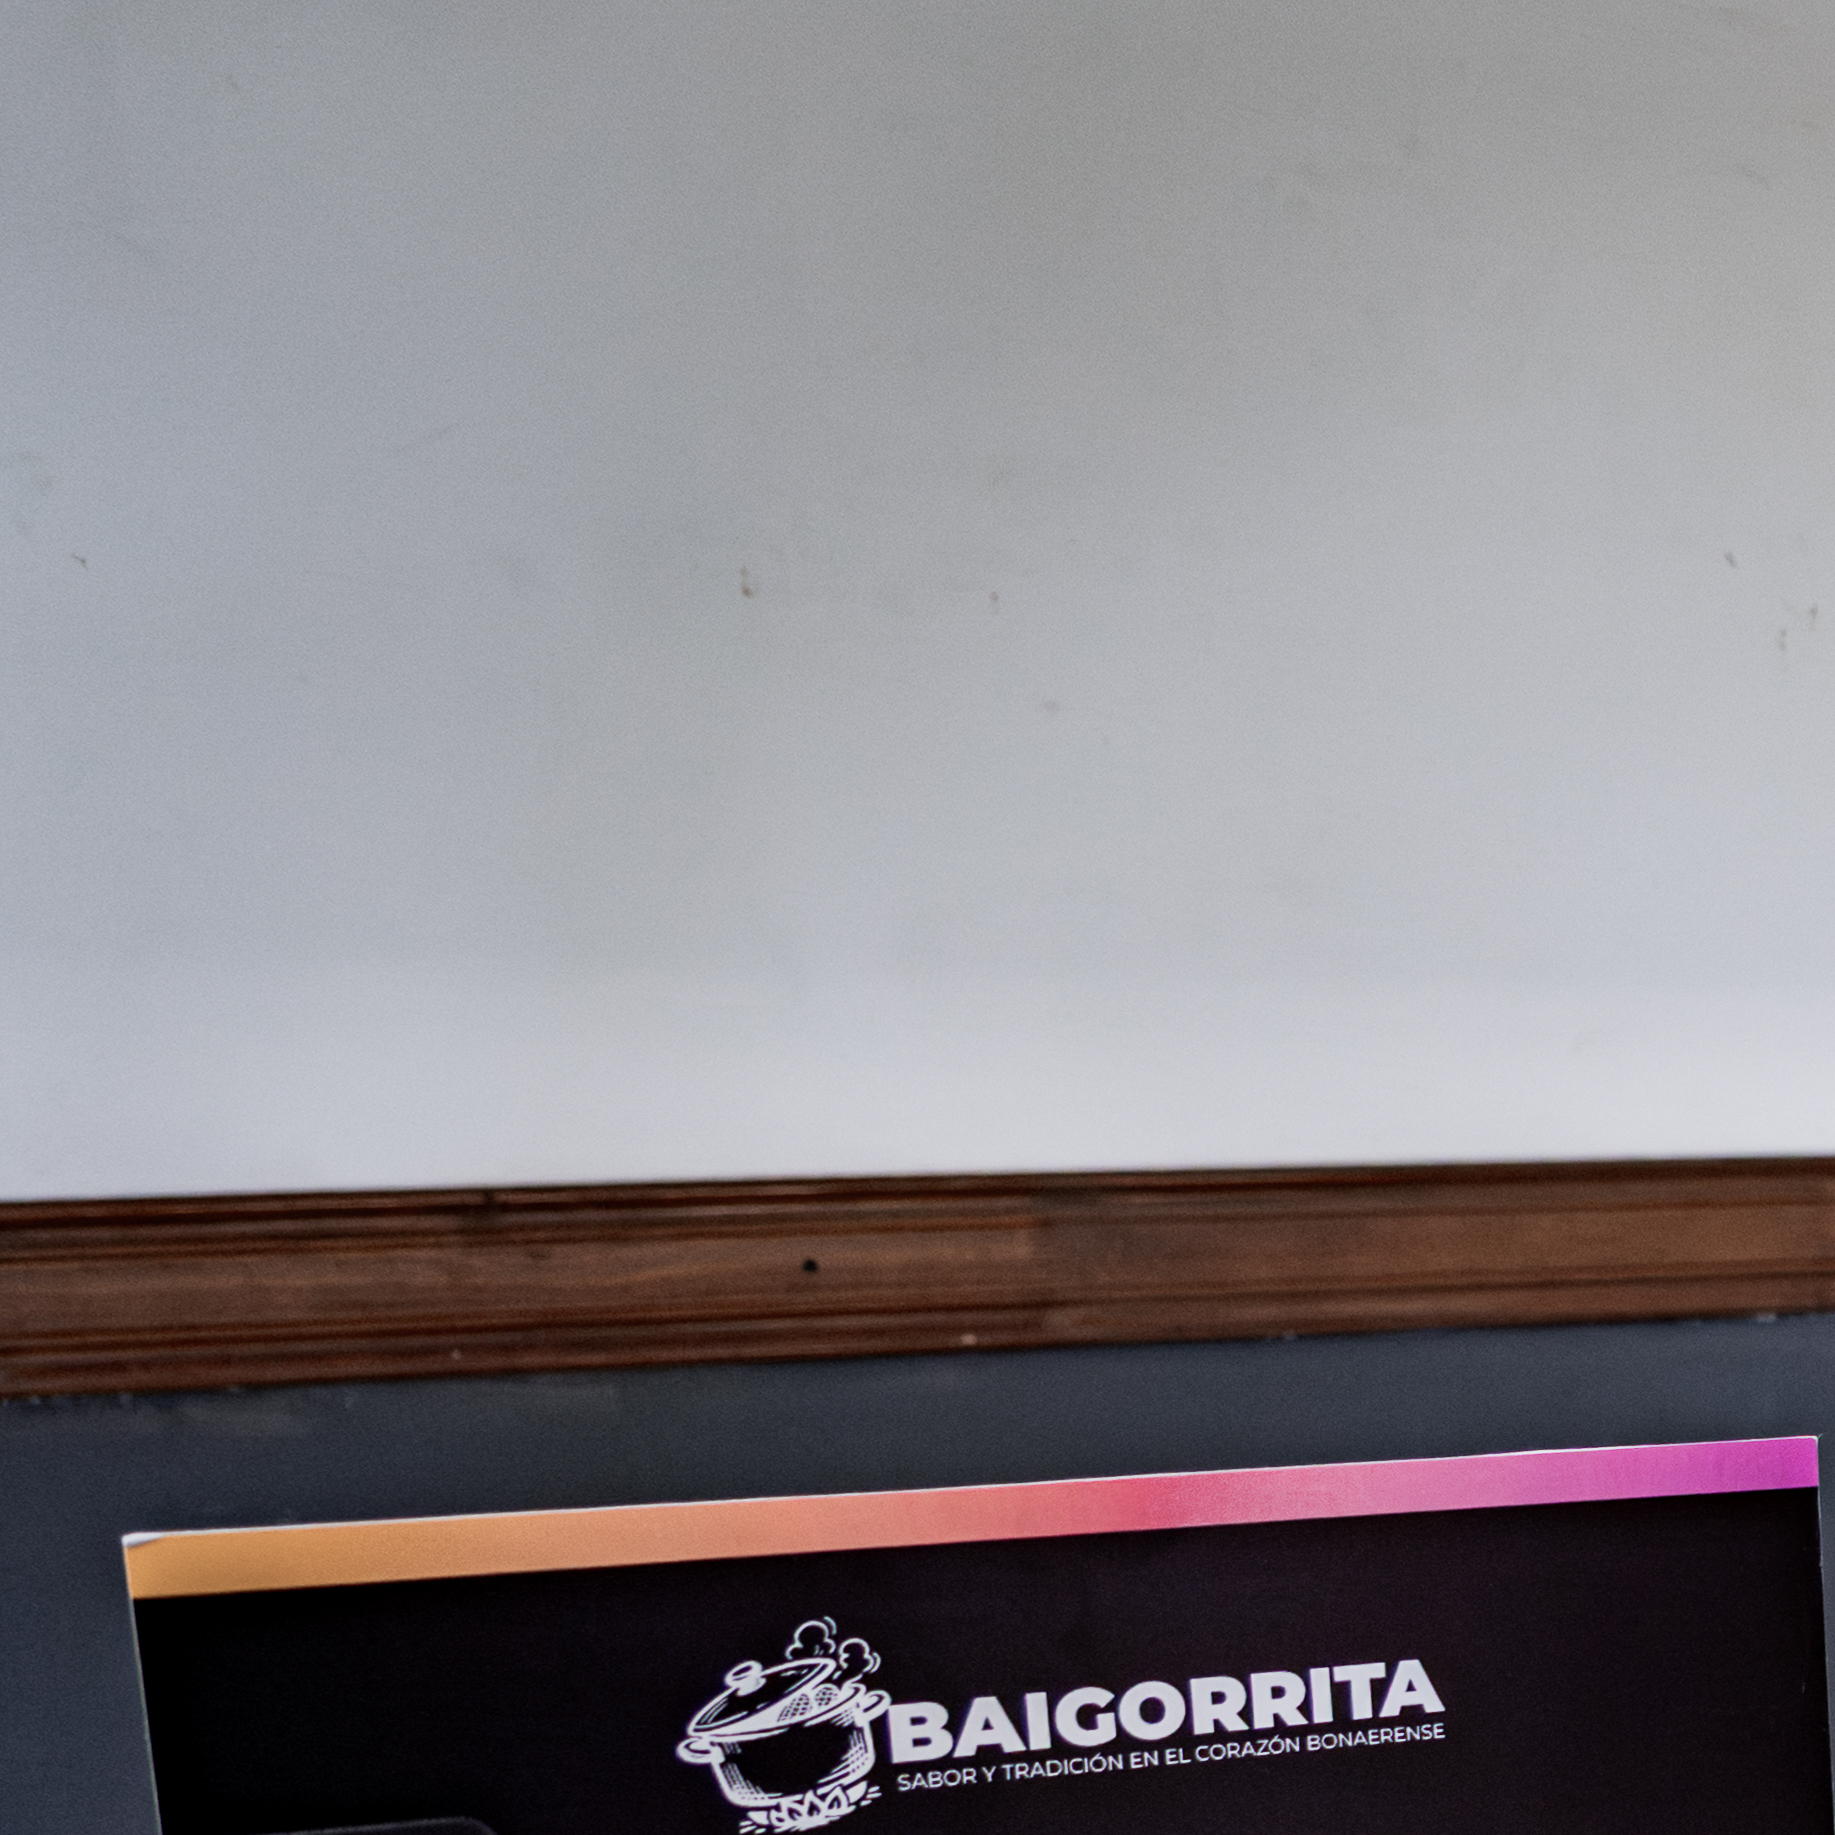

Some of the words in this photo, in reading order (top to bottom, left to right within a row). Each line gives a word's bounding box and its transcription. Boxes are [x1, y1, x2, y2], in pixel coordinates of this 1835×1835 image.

[888, 1658, 1446, 1764] BAIGORRITA
[897, 1766, 977, 1791] SABOR
[982, 1766, 997, 1782] Y
[1002, 1754, 1123, 1780] TRADICIÓN
[1129, 1751, 1160, 1769] EN
[1165, 1748, 1191, 1765] EL
[1195, 1735, 1300, 1761] CORAZÓN
[1306, 1723, 1446, 1751] BONAERENSE
